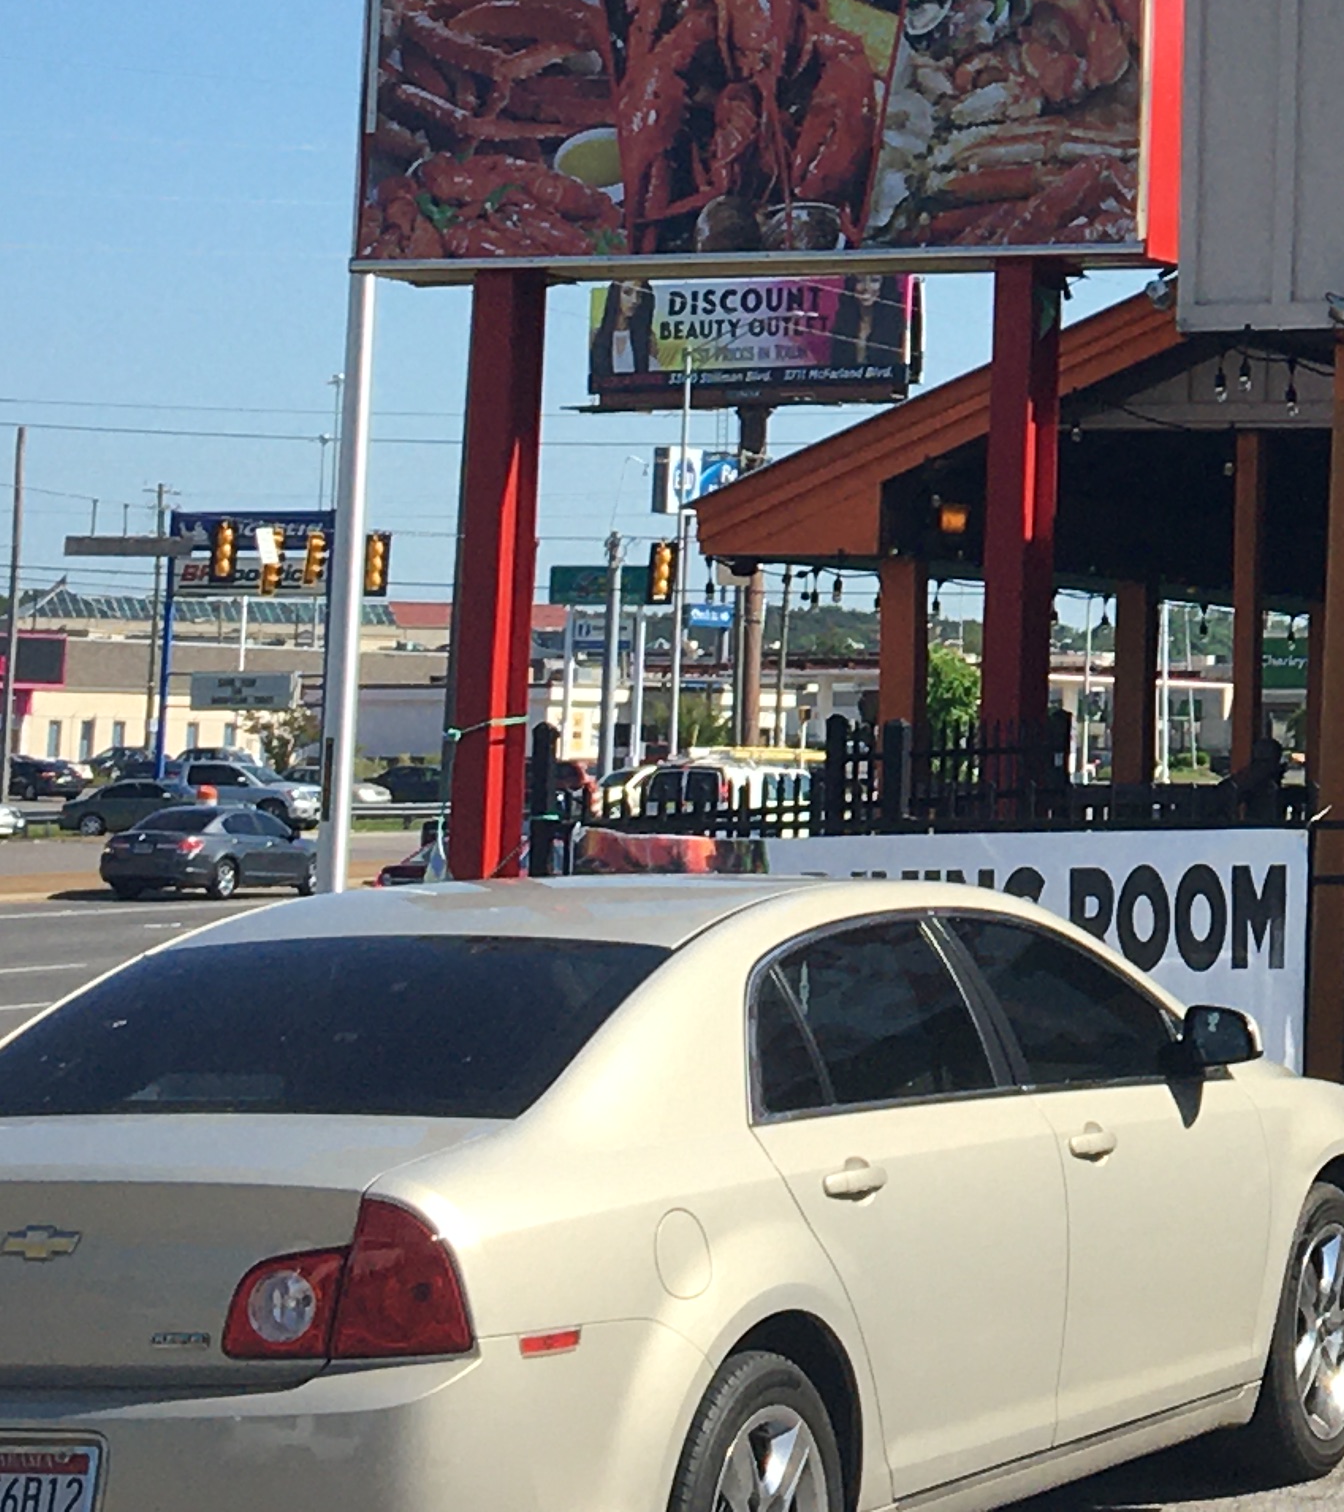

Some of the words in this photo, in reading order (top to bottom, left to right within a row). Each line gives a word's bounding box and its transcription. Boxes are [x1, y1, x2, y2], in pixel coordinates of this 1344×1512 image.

[668, 288, 820, 316] DISCOUNT
[659, 318, 741, 341] BEAUTY
[749, 316, 829, 337] OUTLET
[1069, 864, 1287, 972] ROOM
